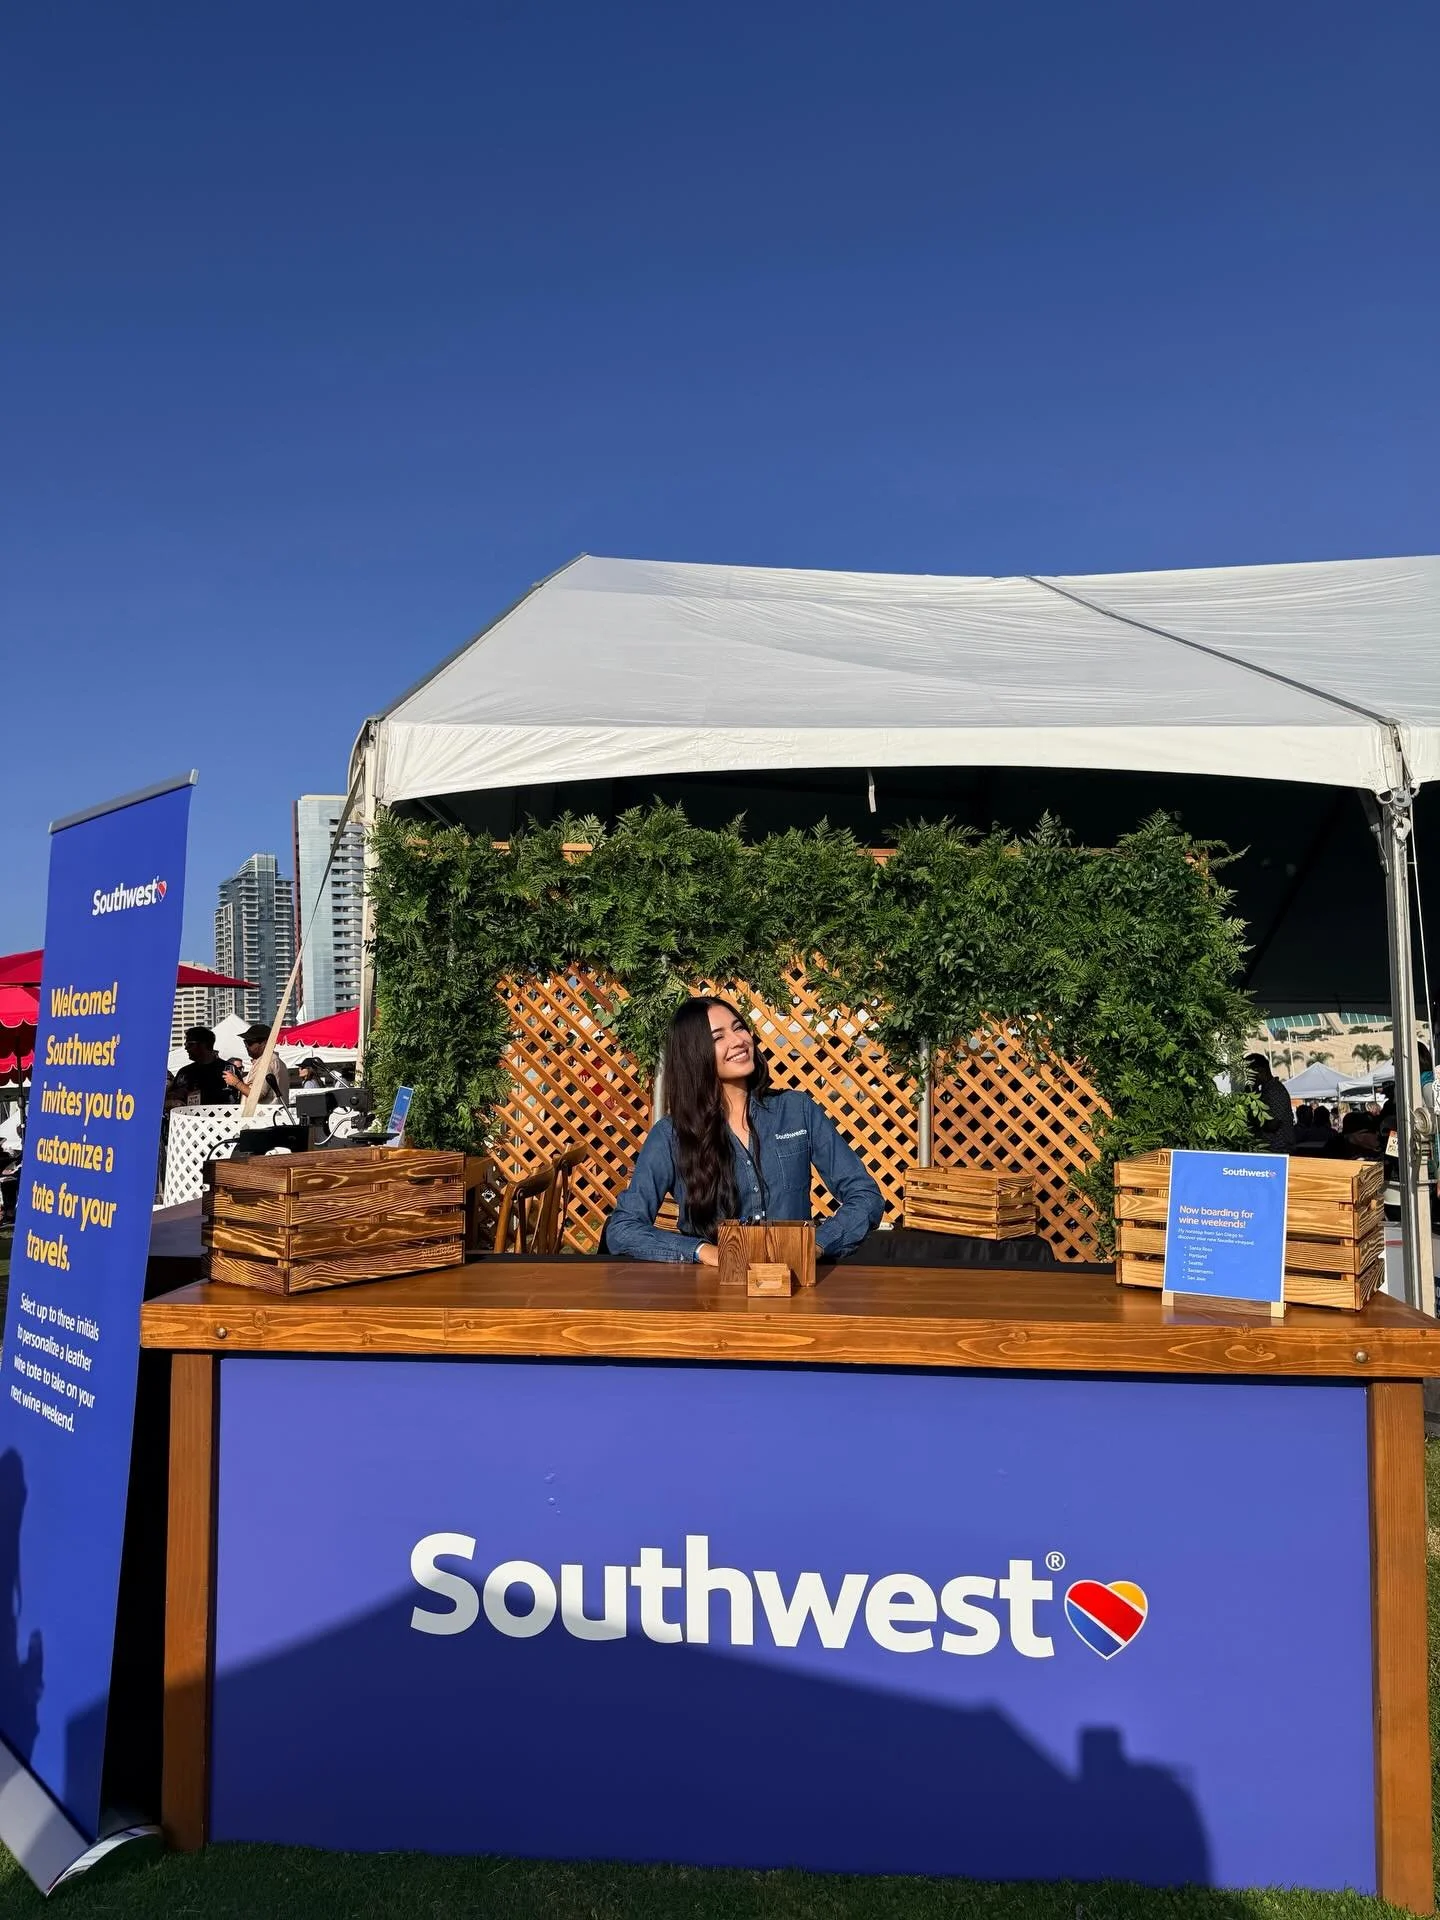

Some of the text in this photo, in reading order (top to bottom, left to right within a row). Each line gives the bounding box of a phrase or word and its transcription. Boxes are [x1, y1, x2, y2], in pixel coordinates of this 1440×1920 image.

[51, 982, 118, 1018] Welcome!
[41, 1081, 135, 1126] invites you to
[37, 1134, 114, 1173] customize a
[1222, 1167, 1269, 1178] Southwest
[32, 1181, 117, 1232] tote for your
[1178, 1216, 1246, 1229] wine weekends!
[1179, 1205, 1254, 1220] Now boarding for
[26, 1229, 70, 1271] travels.
[20, 1292, 100, 1342] Select up to three initials
[17, 1324, 93, 1373] to personalize a leather
[14, 1354, 96, 1409] wine tote to take on your
[10, 1384, 75, 1433] next wine weekend.
